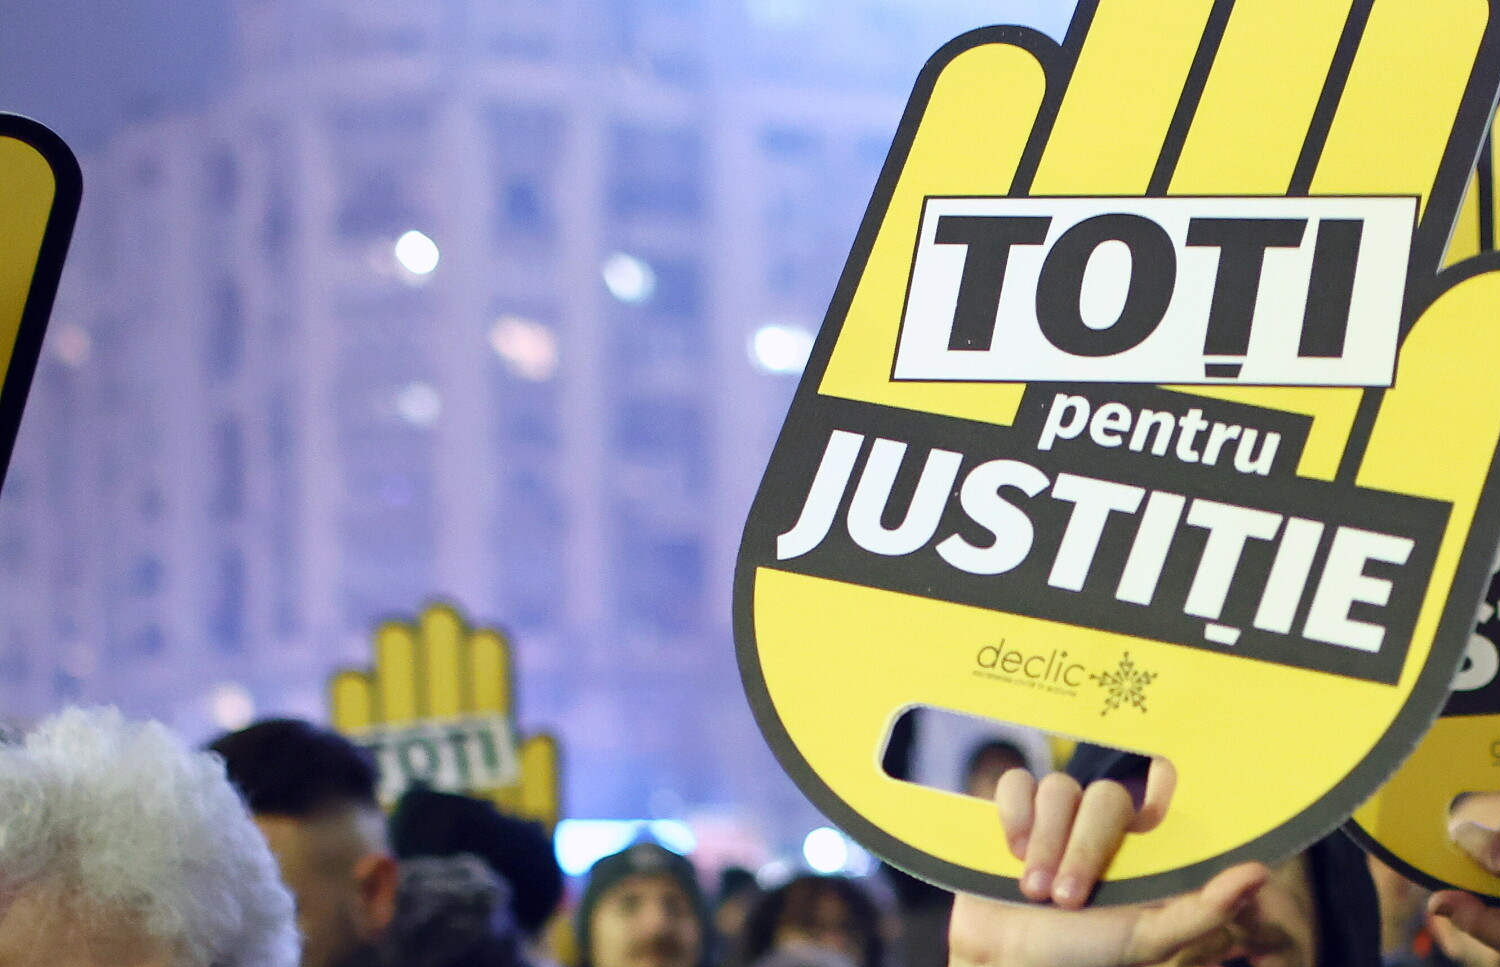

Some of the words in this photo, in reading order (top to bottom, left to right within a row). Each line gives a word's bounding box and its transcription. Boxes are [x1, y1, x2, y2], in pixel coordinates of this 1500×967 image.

[933, 212, 1365, 379] TOȚI
[1037, 391, 1282, 477] pentru
[776, 428, 1416, 654] JUSTIȚIE
[976, 638, 1086, 688] declic
